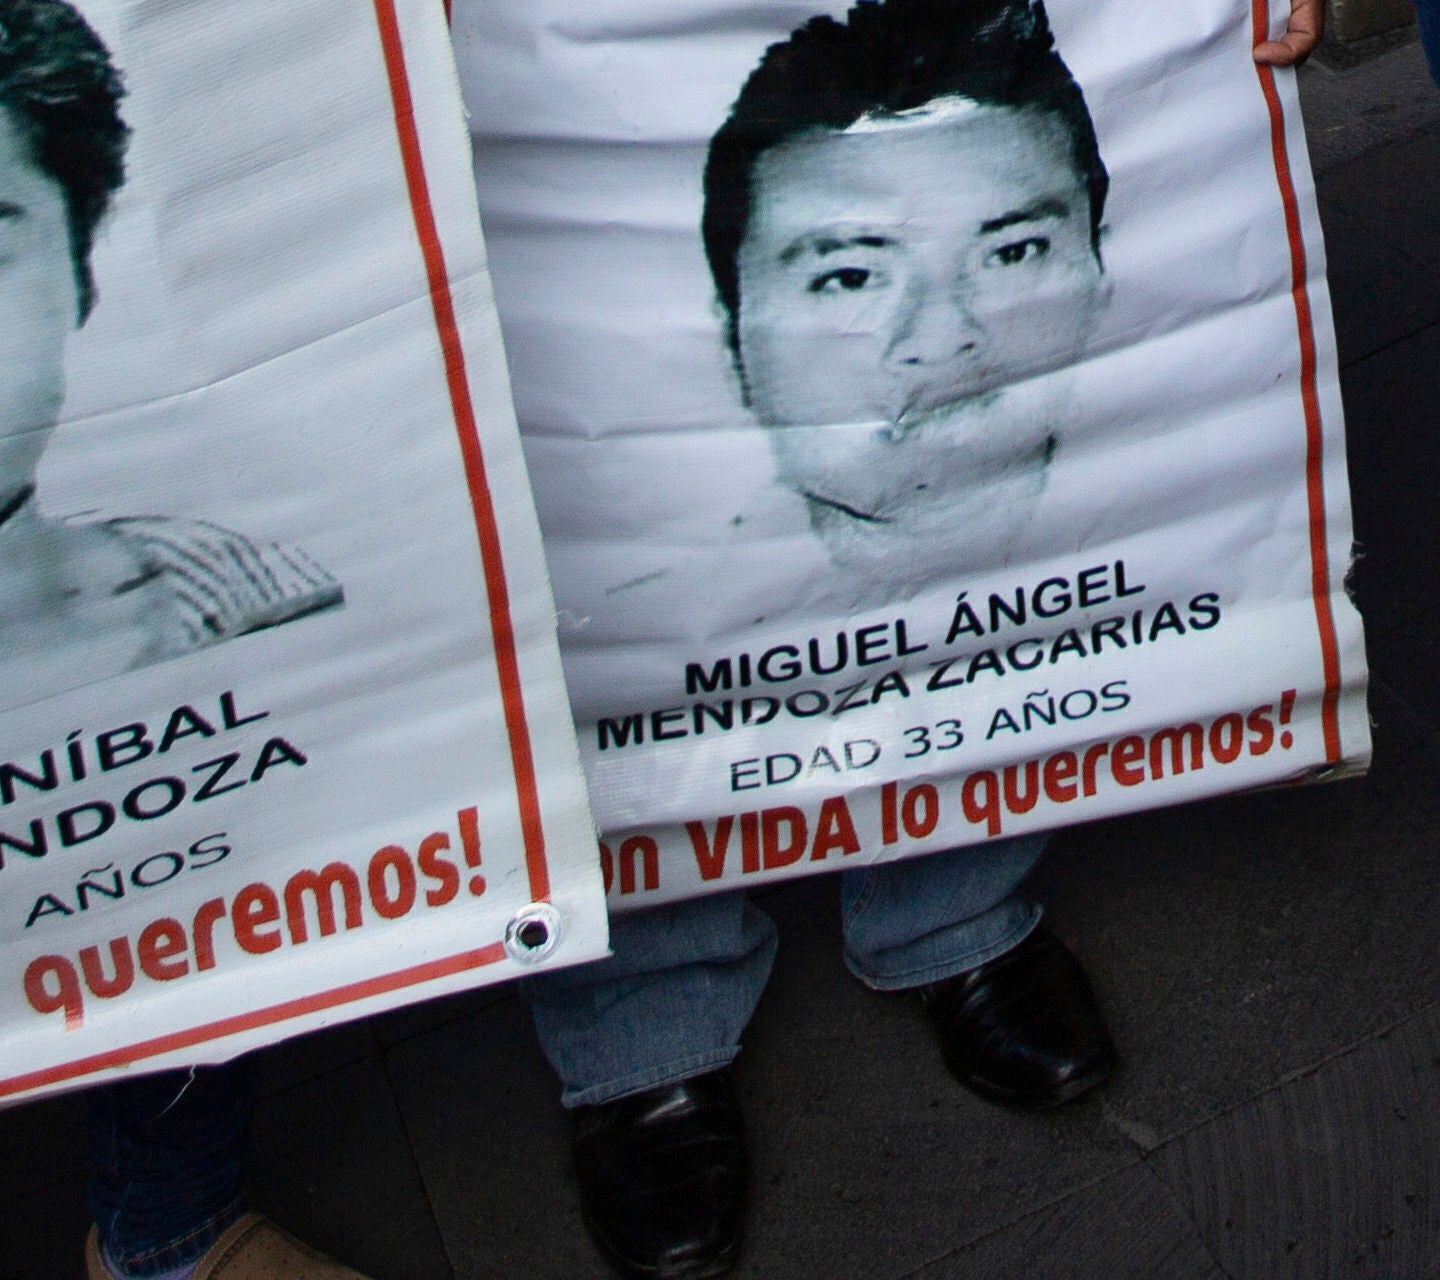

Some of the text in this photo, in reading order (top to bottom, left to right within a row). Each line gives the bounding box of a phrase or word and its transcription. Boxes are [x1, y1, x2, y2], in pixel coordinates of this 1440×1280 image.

[684, 559, 1147, 695] MIGUEL ÁNGEL
[596, 664, 911, 752] MENDOZA
[729, 679, 1133, 793] EDAD 33 AÑOS
[683, 794, 862, 883] VIDA
[879, 780, 940, 846] lo
[959, 687, 1299, 839] queremos!
[22, 804, 490, 1032] queremos!
[23, 831, 234, 929] AÑOS
